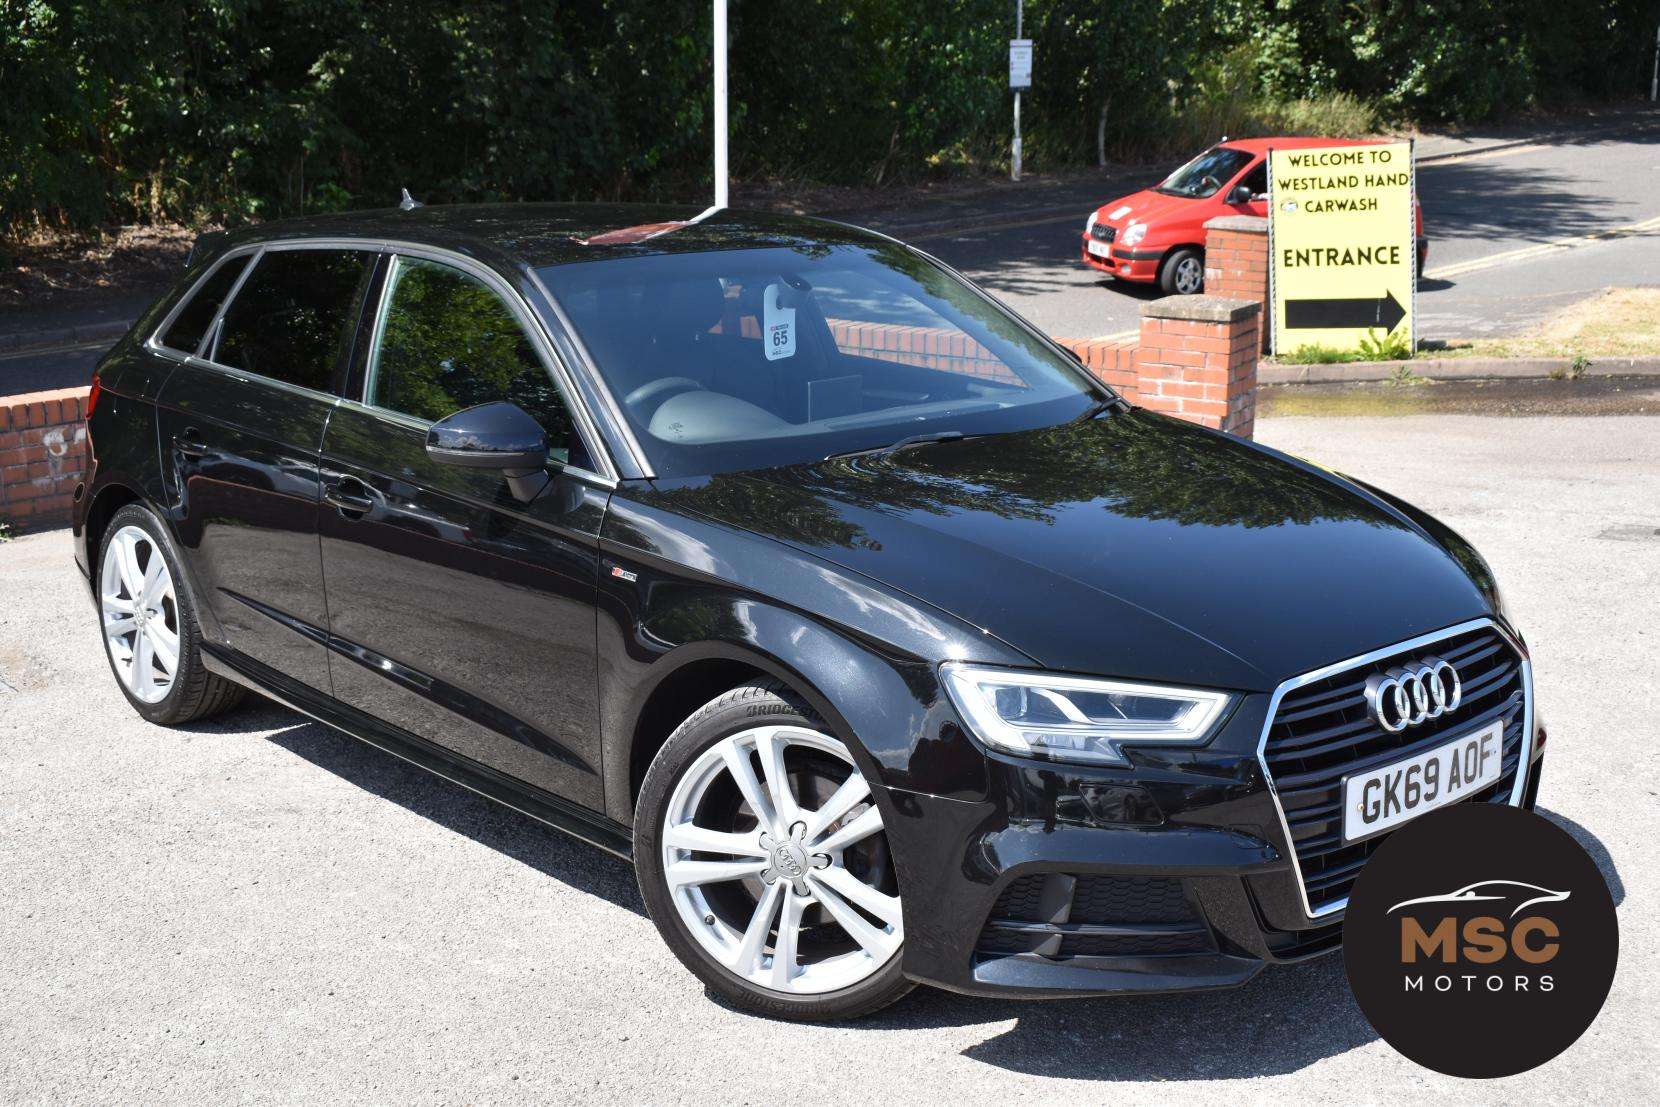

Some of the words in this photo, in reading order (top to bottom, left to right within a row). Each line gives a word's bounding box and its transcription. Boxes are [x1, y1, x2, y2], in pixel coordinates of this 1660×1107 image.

[1288, 151, 1364, 167] WELCOME
[1369, 150, 1392, 163] TO
[1278, 175, 1359, 191] WESTLAND
[1364, 173, 1409, 187] HAND
[1304, 197, 1378, 213] CARWASH
[1283, 246, 1400, 267] ENTRANCE
[773, 330, 788, 347] 65
[1362, 757, 1440, 824] GK69
[1447, 732, 1493, 793] AOF
